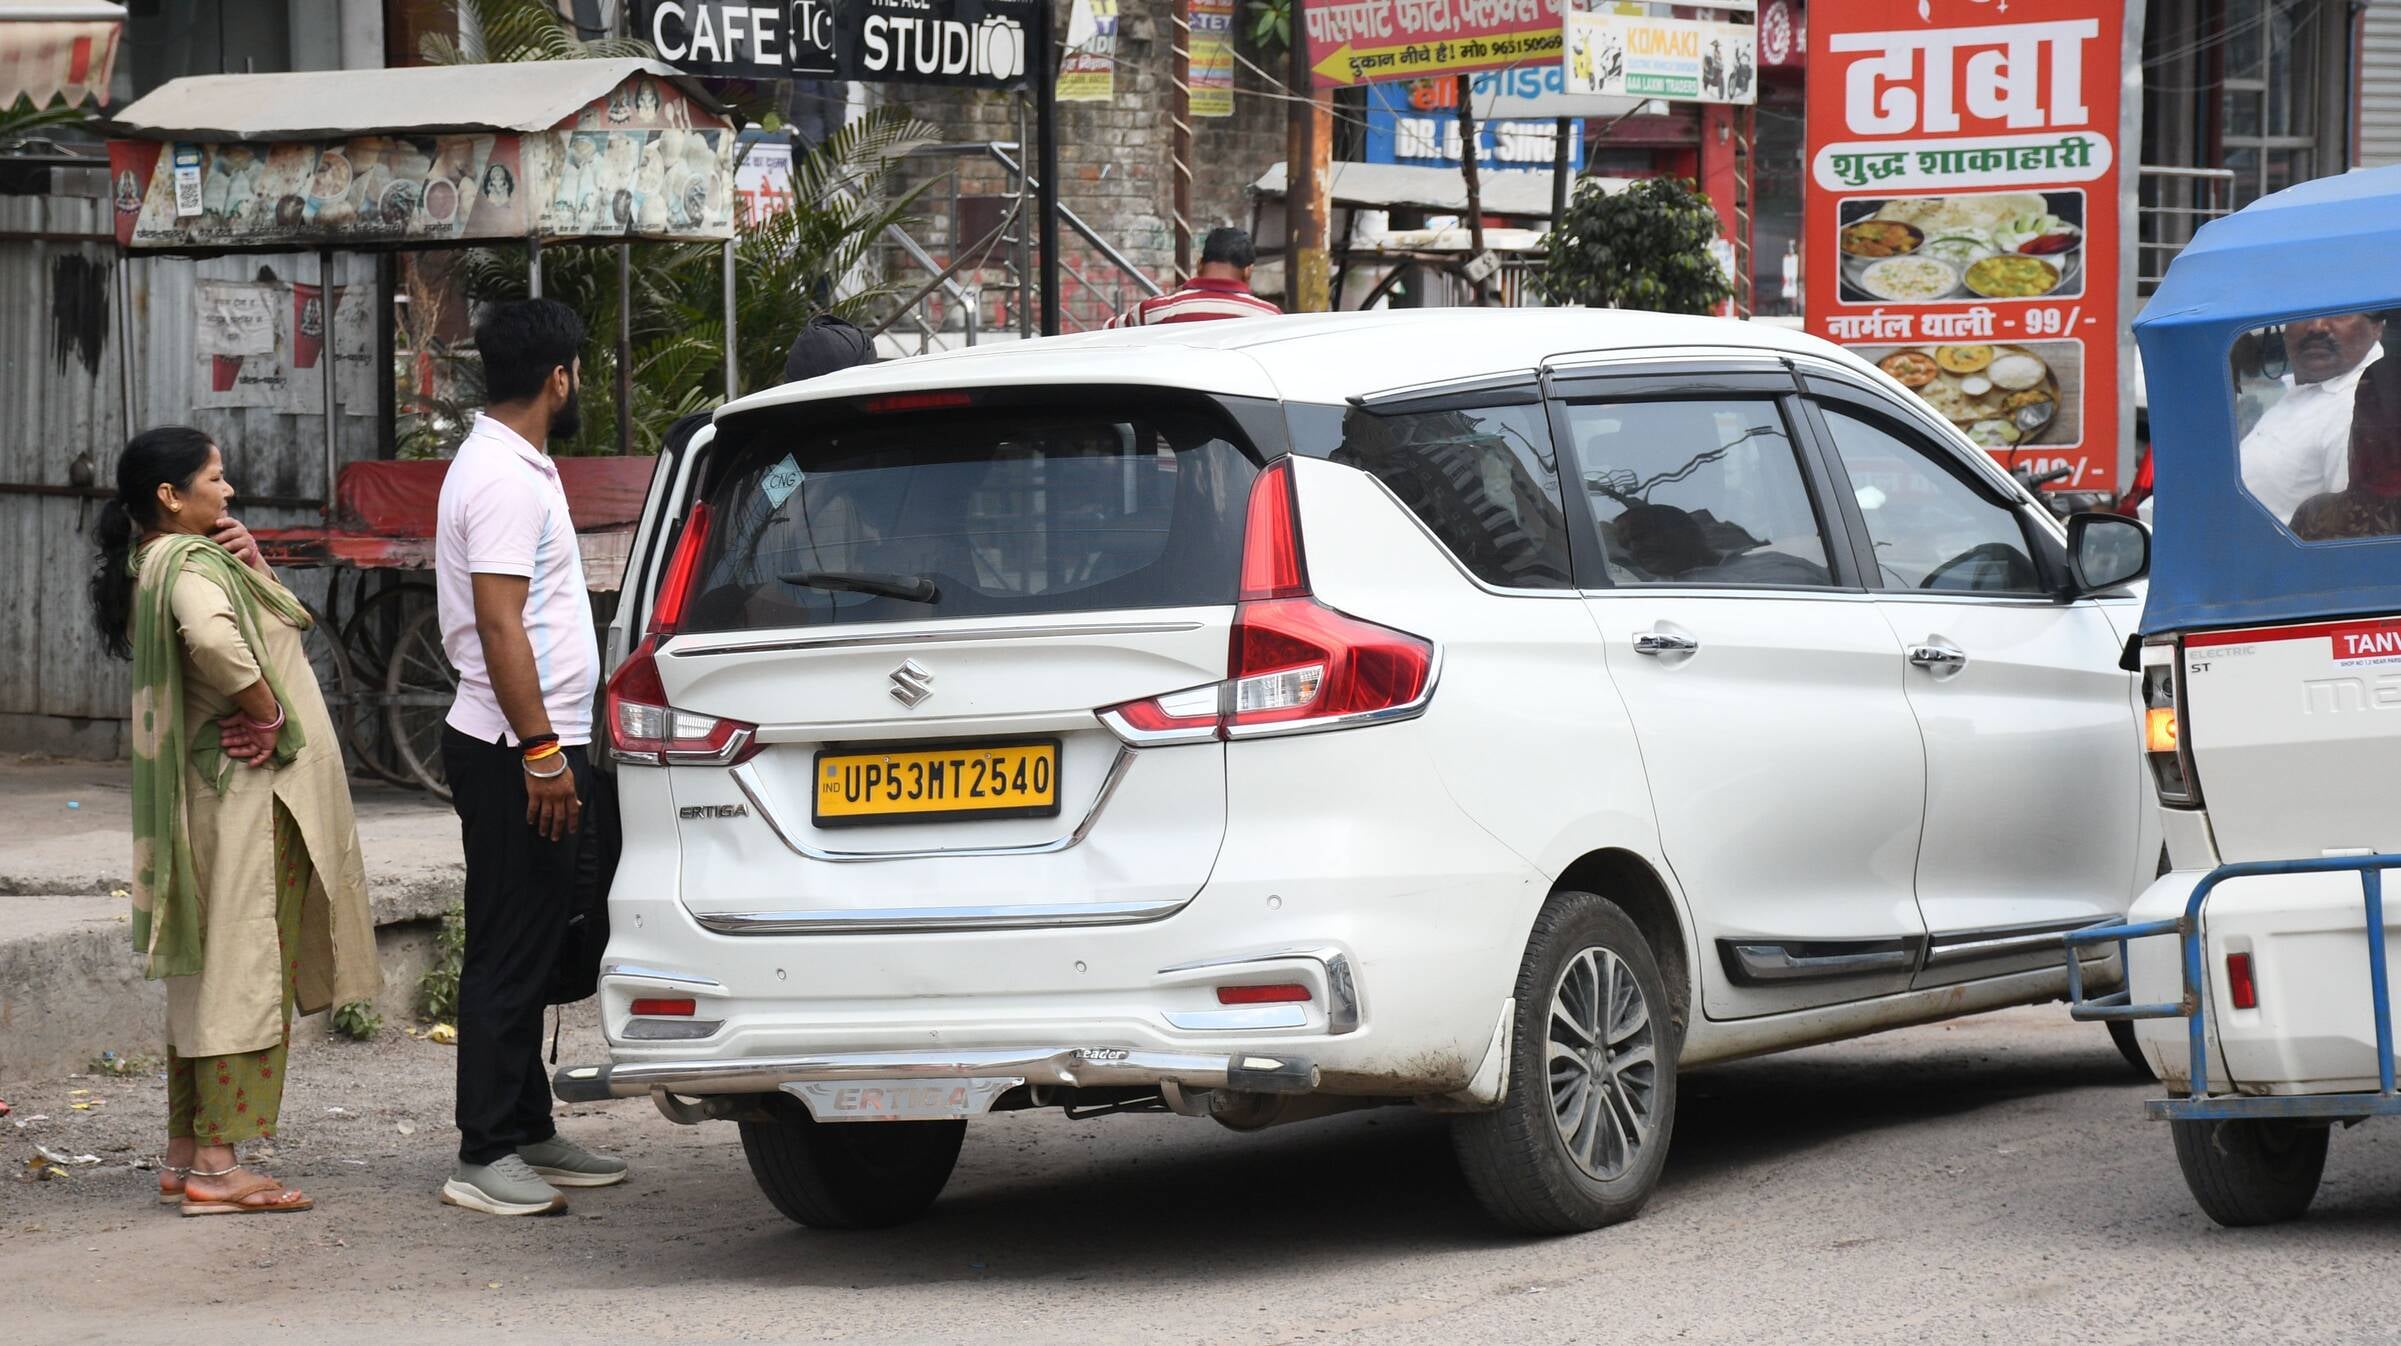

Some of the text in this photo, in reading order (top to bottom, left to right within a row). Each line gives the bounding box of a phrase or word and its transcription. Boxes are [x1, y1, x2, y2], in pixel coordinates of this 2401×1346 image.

[653, 1, 783, 65] CAFE
[1626, 26, 1700, 58] KOMAKI
[1349, 53, 1396, 76] दुकान
[1400, 45, 1431, 63] नीचे
[1829, 18, 2099, 135] ढाबा
[1395, 117, 1442, 158] DR.
[1495, 121, 1579, 164] SING
[1830, 136, 2095, 186] शुद्ध शाकाहारी
[769, 471, 797, 489] CNG
[2189, 645, 2256, 659] ELECTRIC
[2190, 662, 2212, 674] ST
[823, 755, 1050, 803] IND UP53MT2540
[679, 802, 750, 820] ERTIGA
[832, 1087, 970, 1111] ERTIGA
